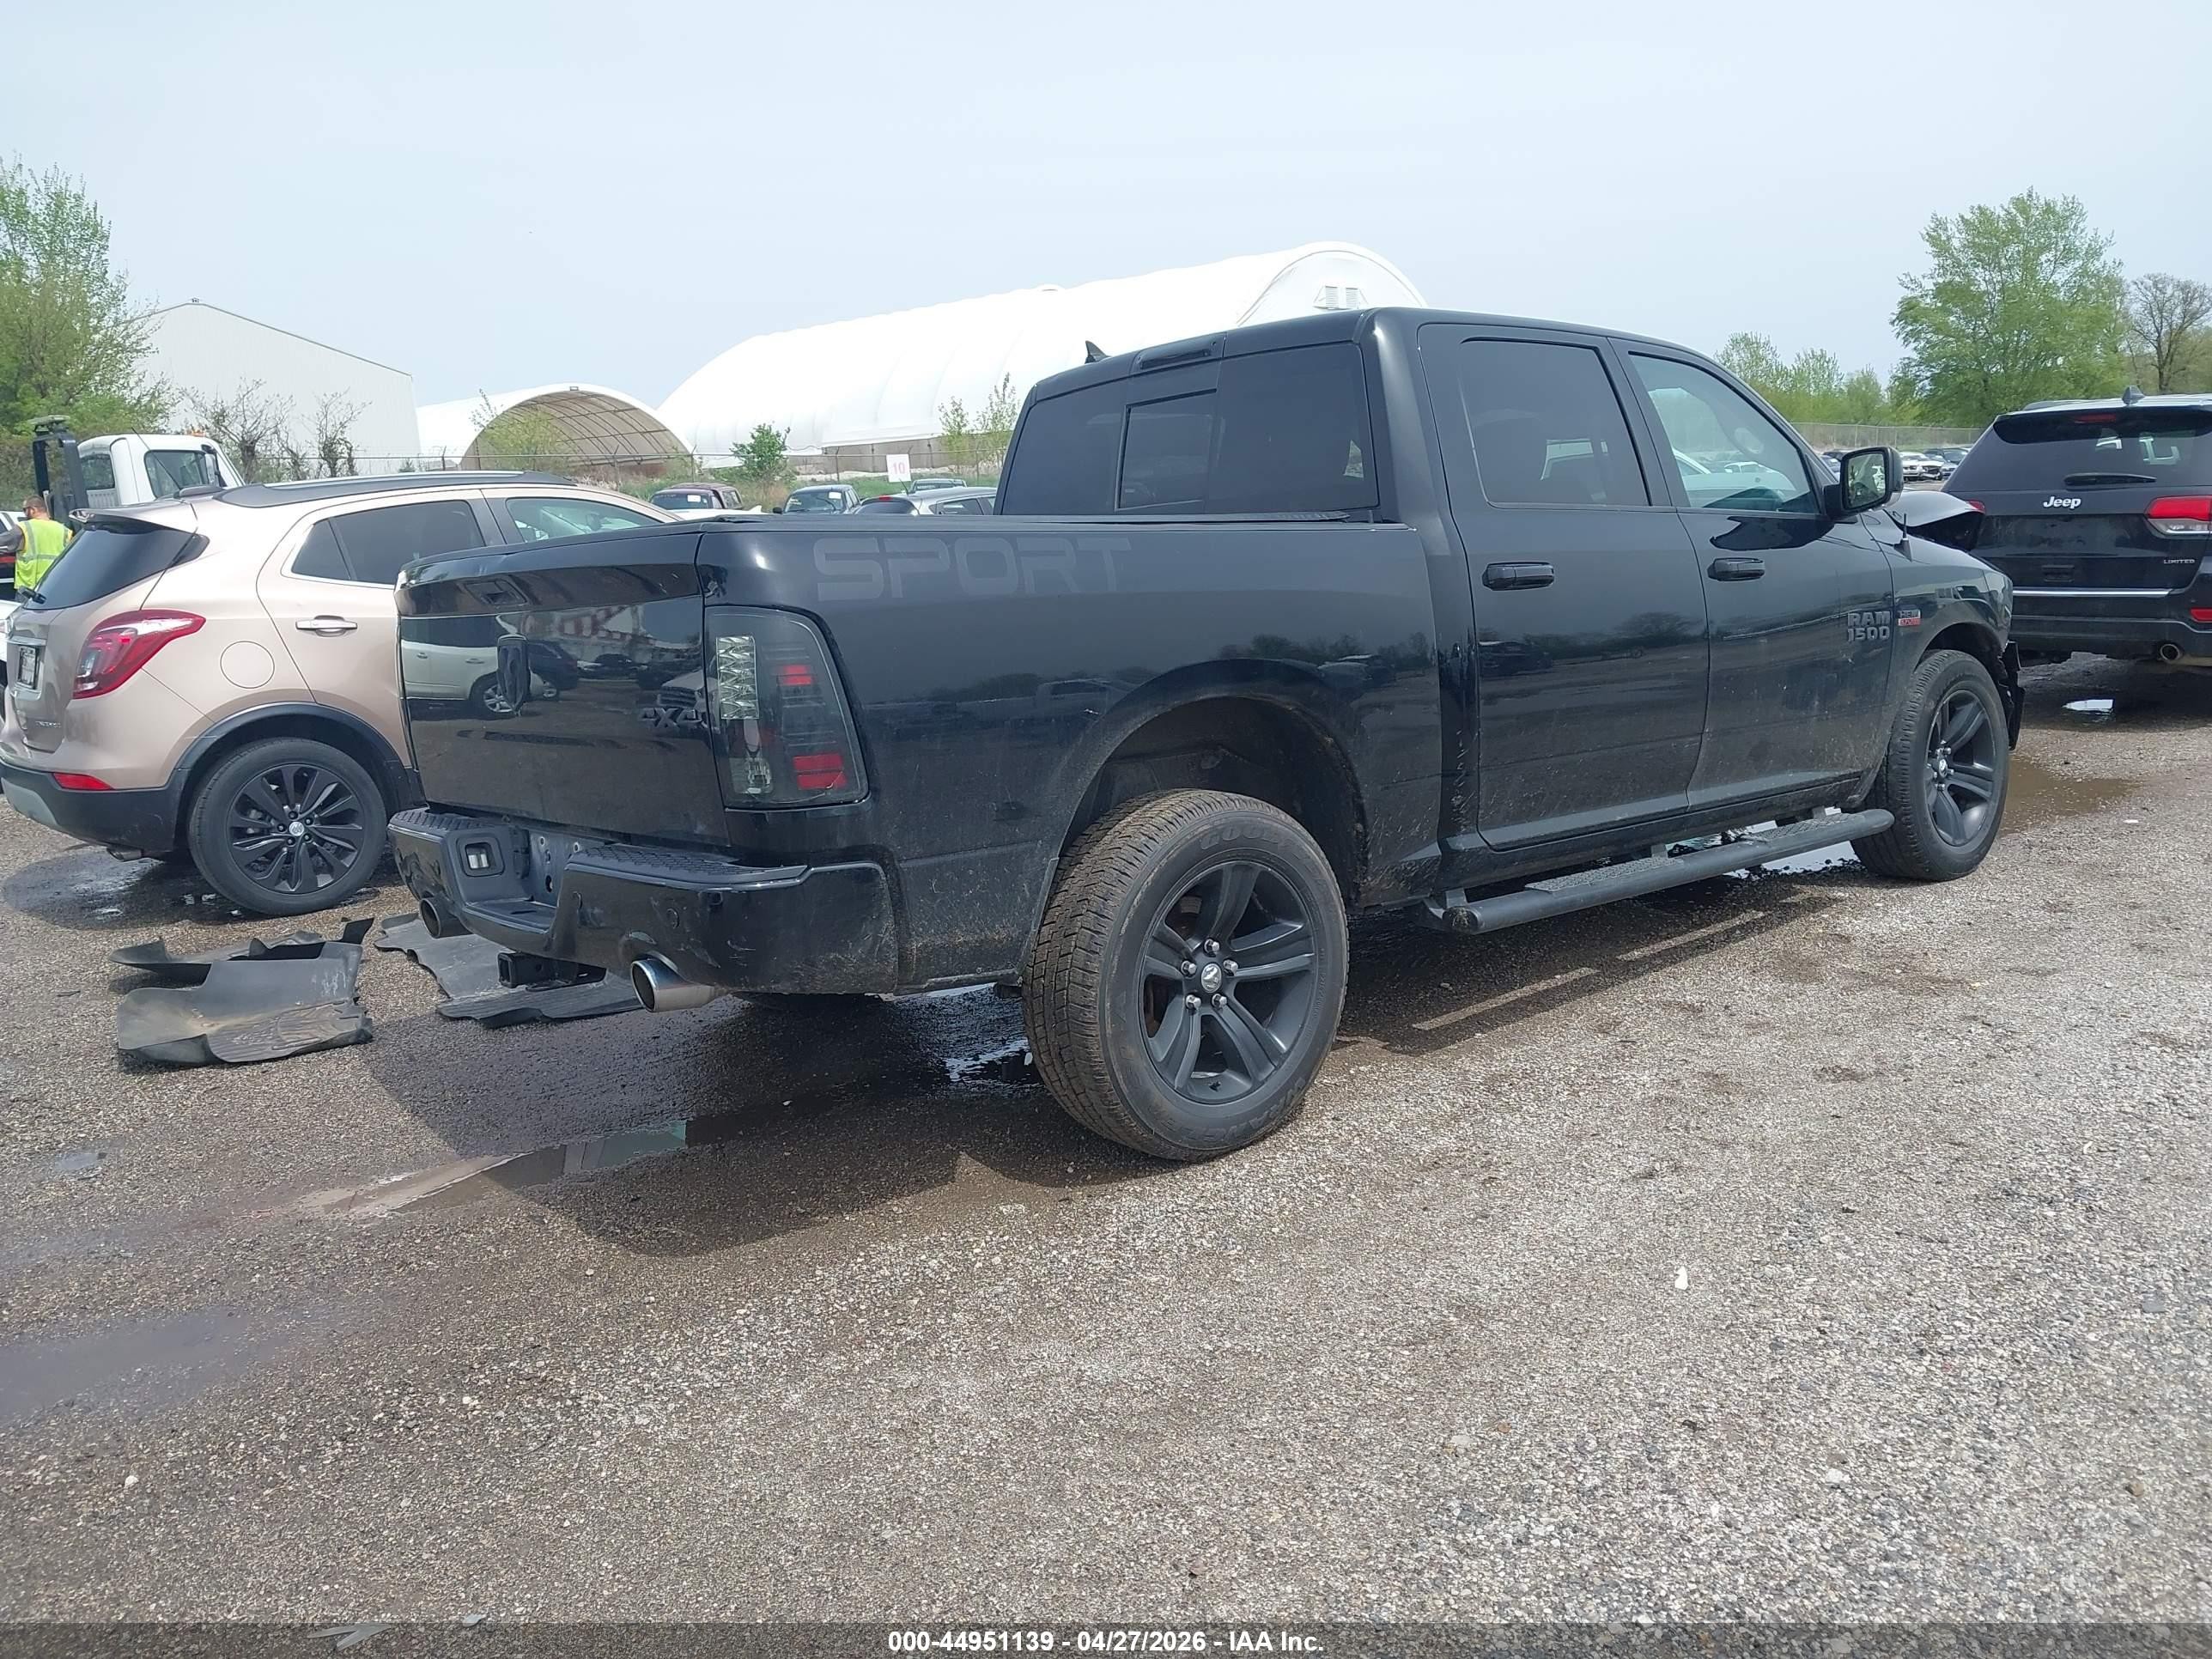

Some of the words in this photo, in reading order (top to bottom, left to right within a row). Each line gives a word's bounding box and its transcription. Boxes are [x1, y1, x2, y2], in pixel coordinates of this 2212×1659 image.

[893, 462, 906, 475] 10
[2043, 495, 2081, 509] Jeep
[812, 537, 1132, 602] SPORT
[1847, 611, 1891, 627] RAM
[1847, 625, 1890, 642] 1500
